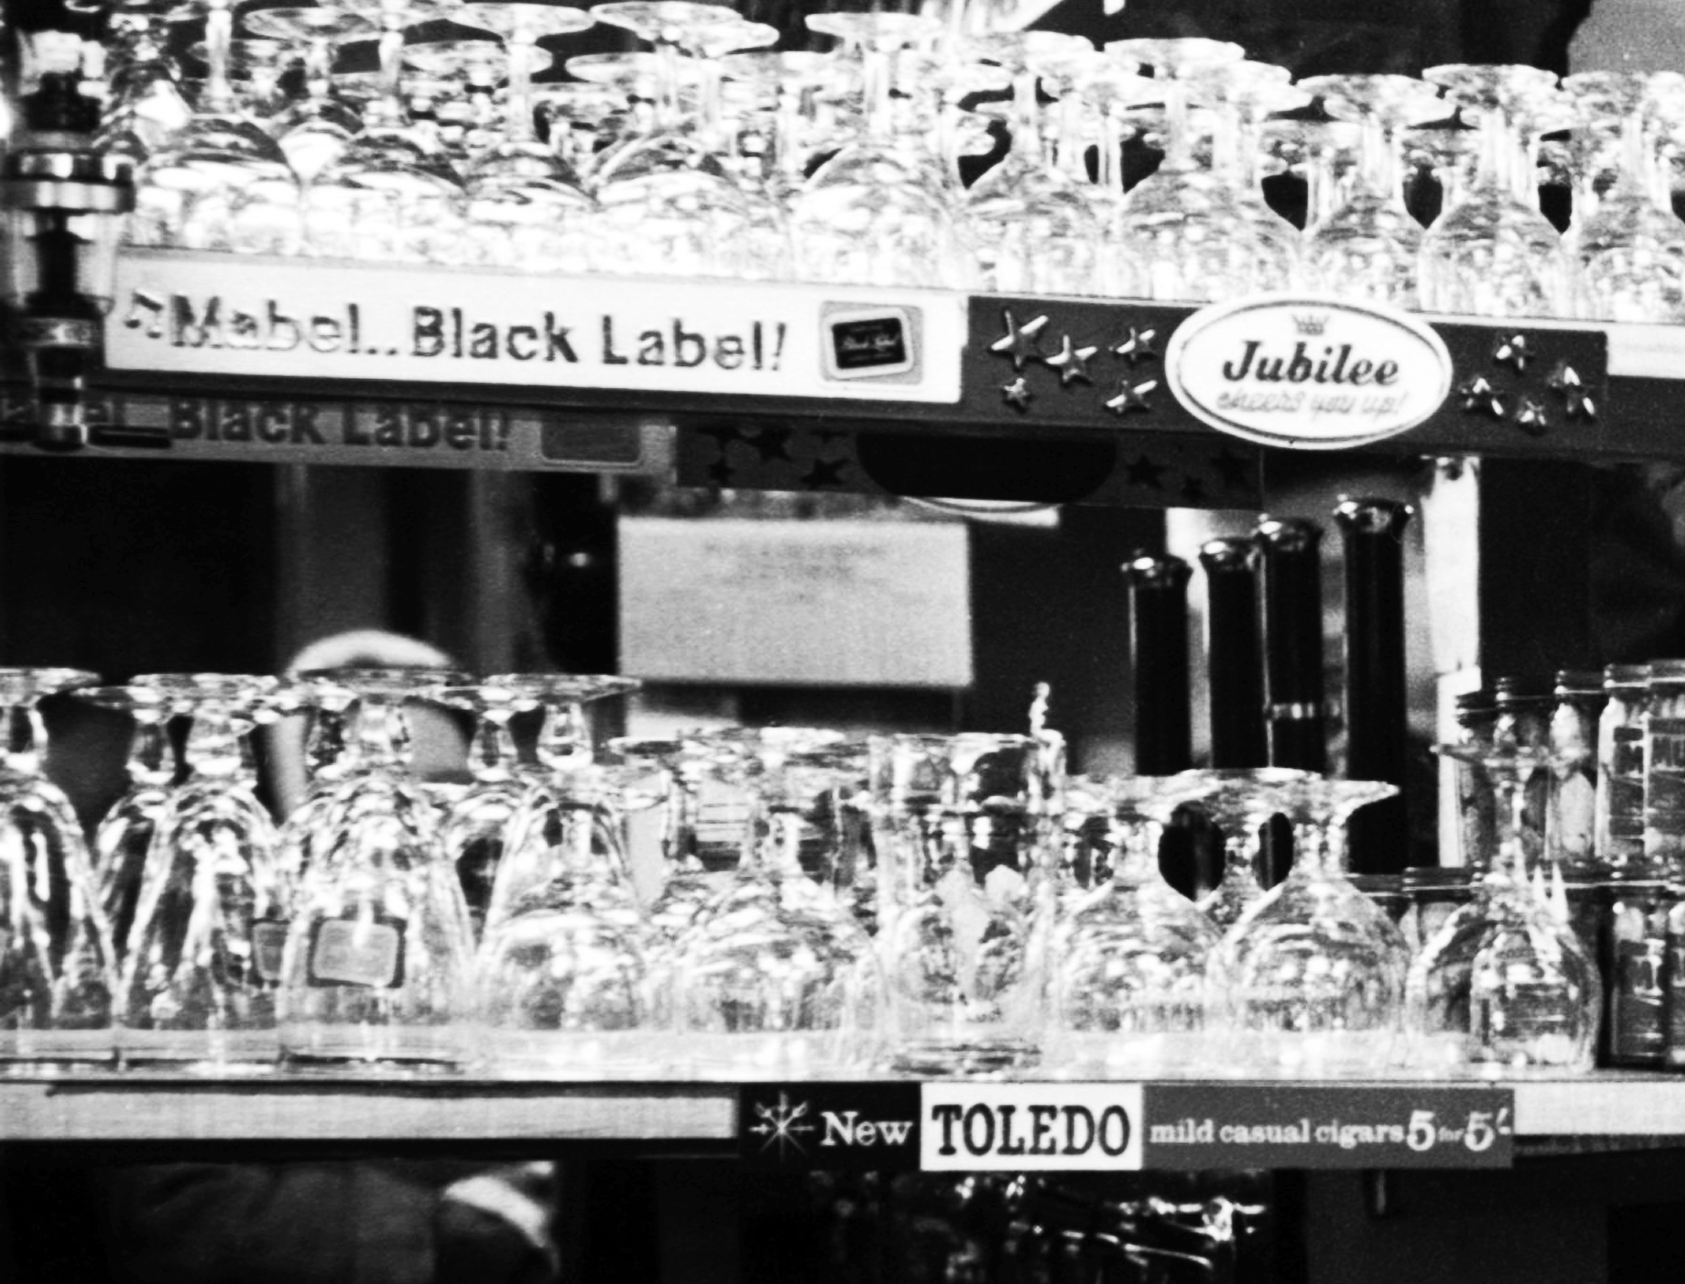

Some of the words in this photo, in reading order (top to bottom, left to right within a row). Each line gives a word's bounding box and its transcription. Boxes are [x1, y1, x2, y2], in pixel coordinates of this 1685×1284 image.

[411, 306, 579, 364] Black
[601, 314, 789, 372] Label!
[1222, 340, 1400, 388] Jubilee
[172, 400, 326, 445] Black
[1216, 387, 1303, 416] cheers
[1309, 394, 1352, 420] you
[820, 1110, 913, 1147] New
[931, 1102, 1131, 1157] TOLEDO
[1149, 1118, 1214, 1145] mild
[1218, 1119, 1311, 1145] casual
[1314, 1120, 1405, 1152] cigars
[1406, 1108, 1437, 1152] 5
